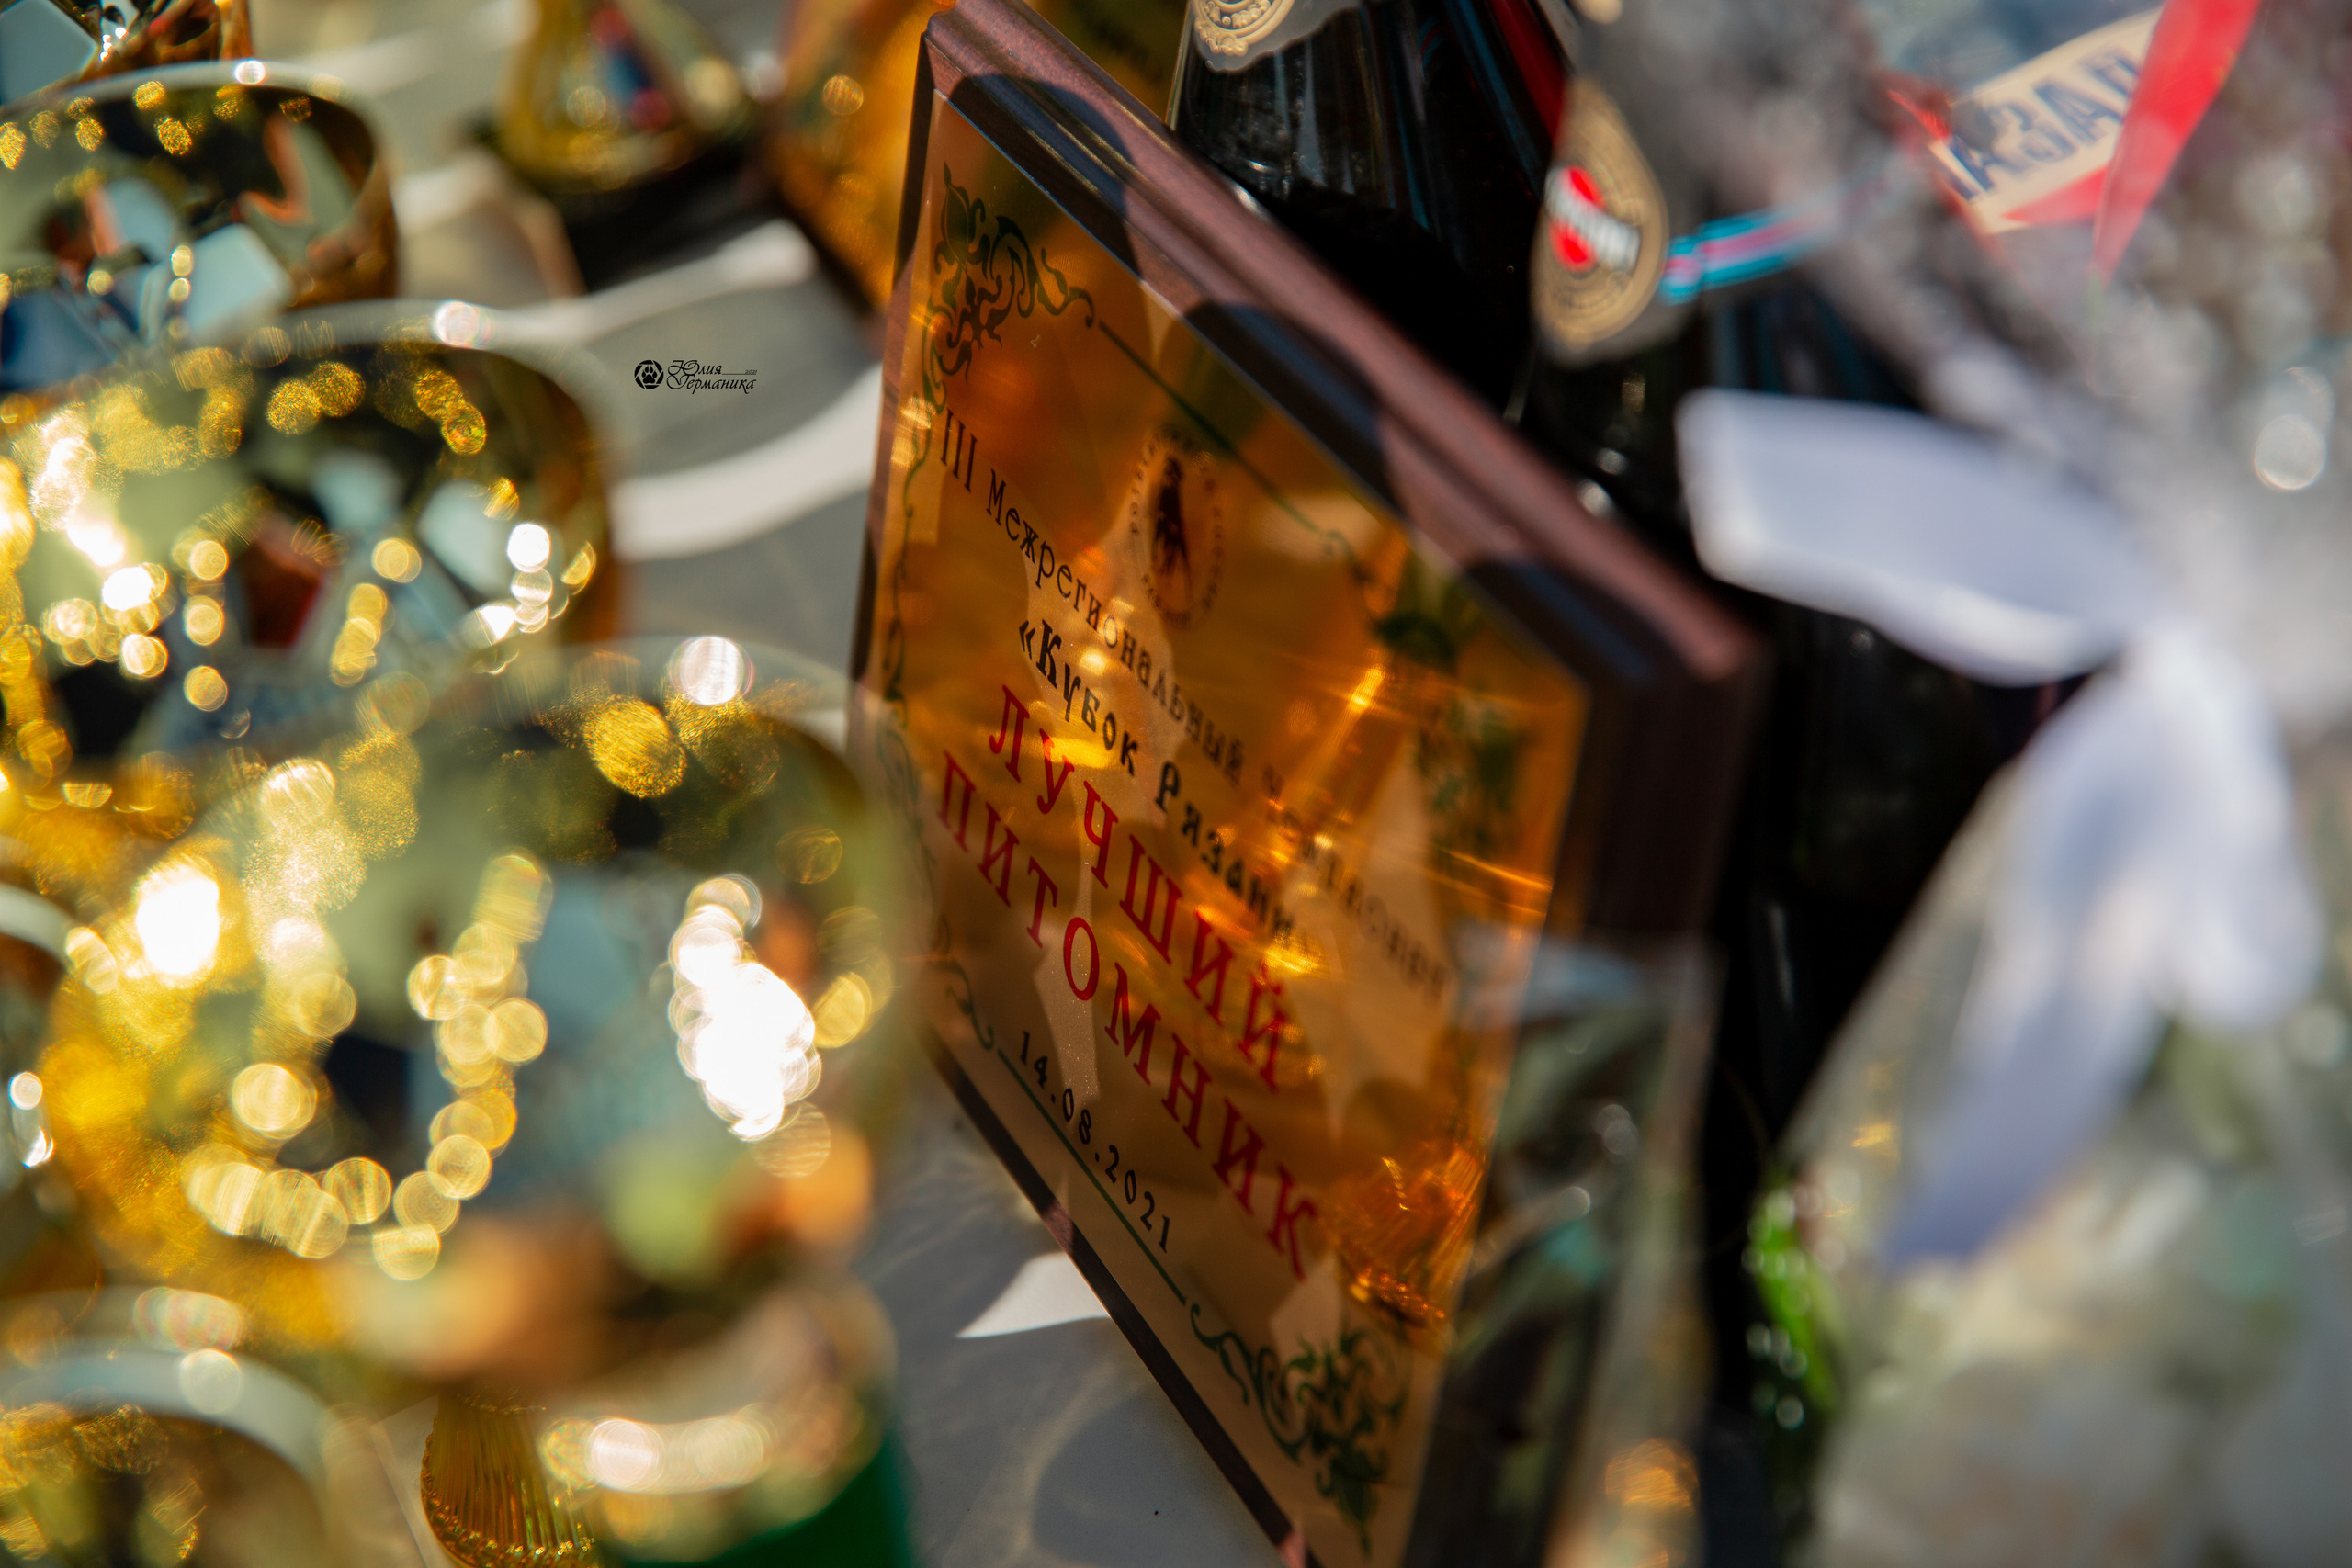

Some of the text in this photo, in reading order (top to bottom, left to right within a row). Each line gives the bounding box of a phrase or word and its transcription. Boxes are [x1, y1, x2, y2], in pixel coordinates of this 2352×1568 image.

[940, 408, 978, 492] III
[986, 468, 1245, 788] Межрегиональный
[936, 750, 1319, 1283] ПИТОМНИК
[989, 683, 1292, 1095] ЛУЧШИЙ
[1019, 1031, 1171, 1255] 14.08.2021
